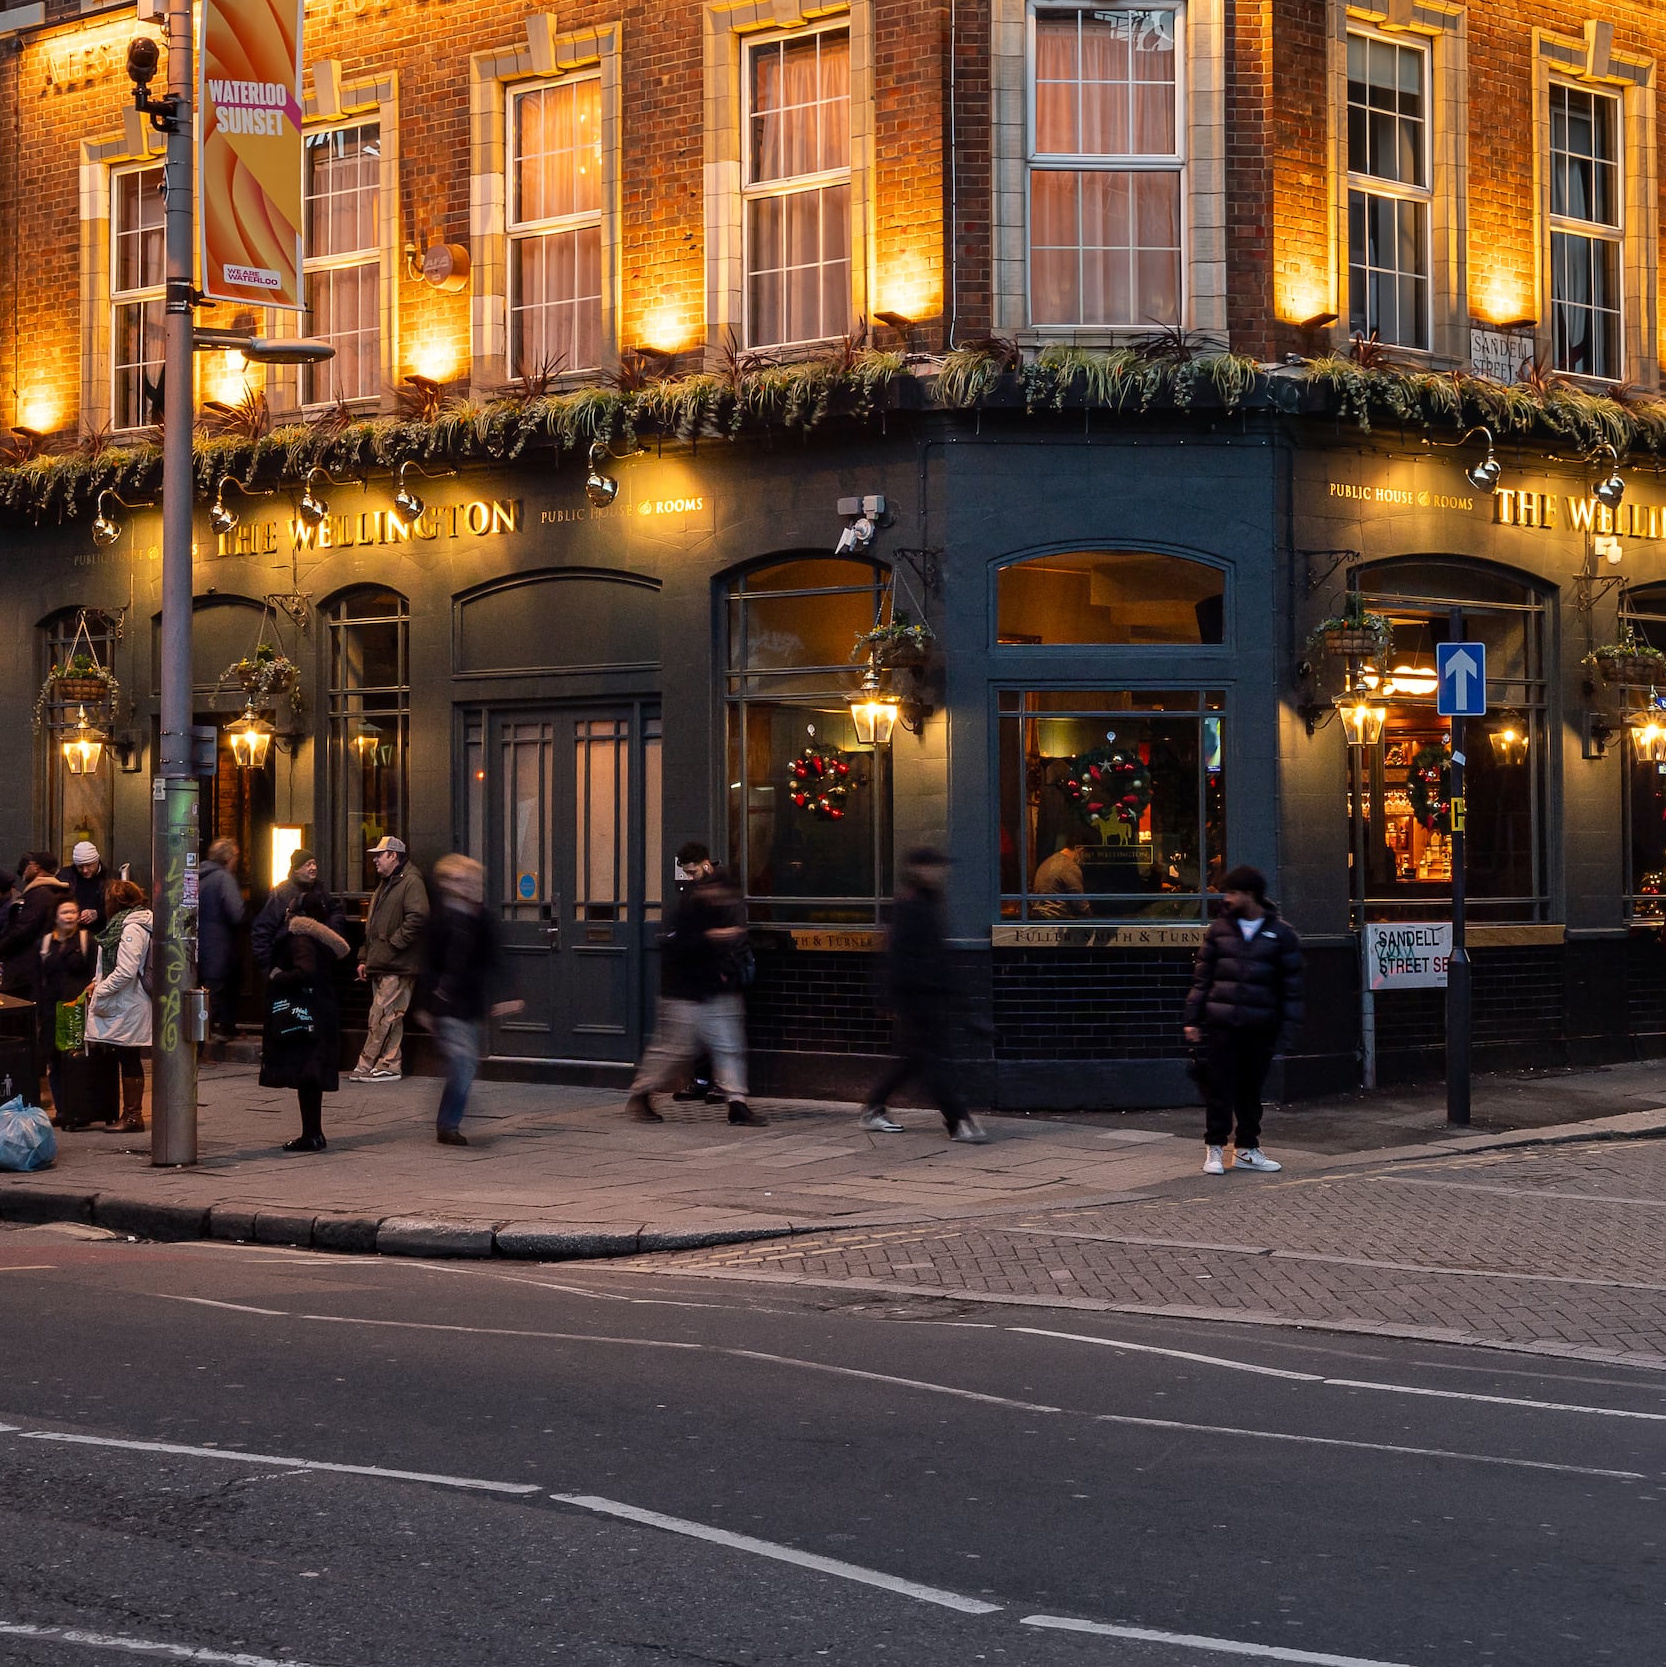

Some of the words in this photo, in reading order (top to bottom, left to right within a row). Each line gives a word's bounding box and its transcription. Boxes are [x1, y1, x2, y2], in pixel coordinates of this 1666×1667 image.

[209, 79, 287, 107] WATERLOO
[216, 106, 283, 136] SUNSET
[228, 274, 278, 286] WATERLOO
[1474, 336, 1527, 360] SANDELL
[1473, 358, 1514, 382] STREET
[1330, 484, 1371, 501] PUBLIC
[1376, 487, 1413, 505] HOUSE
[1434, 494, 1473, 511] ROOMS
[1495, 487, 1557, 529] THE
[541, 508, 584, 524] PUBLIC
[656, 497, 703, 514] ROOMS
[286, 498, 519, 552] WELLINGTON
[813, 935, 821, 946] &
[1139, 931, 1150, 942] &
[1379, 929, 1439, 947] SANDELL
[1379, 957, 1429, 974] STREET
